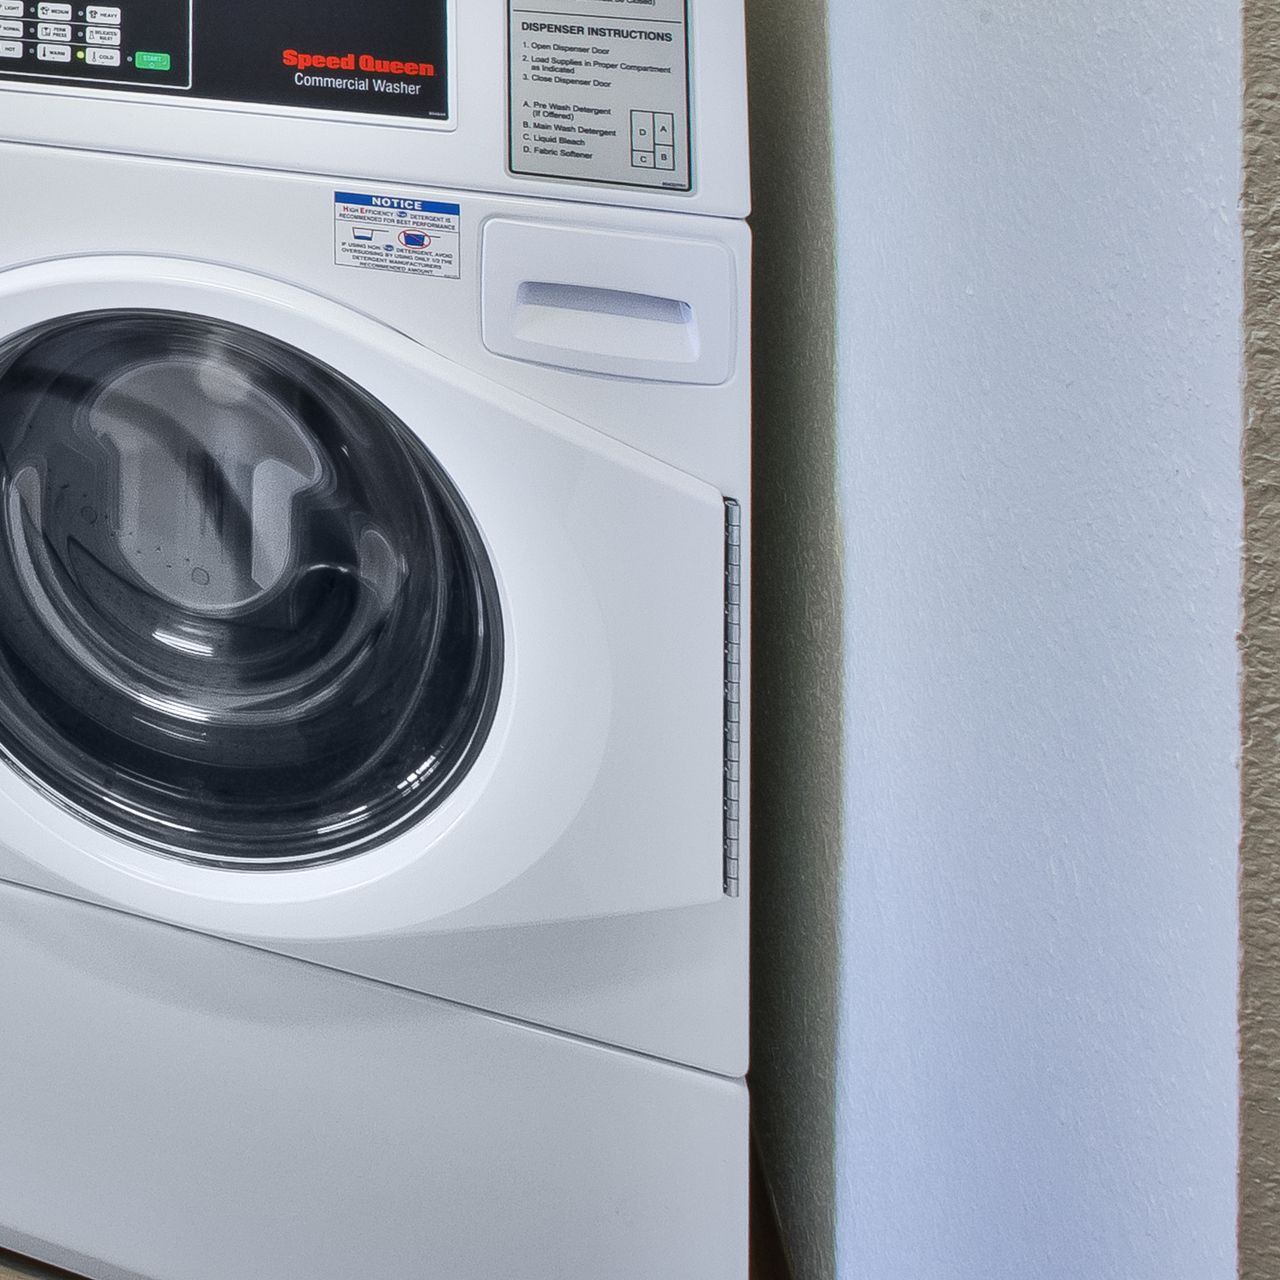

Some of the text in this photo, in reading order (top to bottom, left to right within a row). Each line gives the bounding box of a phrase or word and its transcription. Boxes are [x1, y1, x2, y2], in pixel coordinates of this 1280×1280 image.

[522, 22, 672, 41] DISPENSER INSTRUCTIONS
[531, 42, 551, 50] Open
[553, 44, 590, 53] Dispenser
[283, 49, 434, 76] Speed Queen
[531, 56, 549, 64] Load
[551, 58, 582, 67] Supplies
[593, 61, 618, 70] Proper
[620, 63, 671, 73] Compartment
[542, 65, 575, 74] Indicated
[294, 73, 421, 95] Commercial Washer
[554, 76, 591, 86] Dispenser
[534, 102, 547, 110] Pre
[549, 103, 570, 112] Wash
[573, 106, 611, 115] Detergent
[542, 111, 574, 121] Offered)
[533, 122, 552, 130] Main
[554, 124, 575, 132] Wash
[578, 126, 616, 136] Detergent
[640, 128, 646, 136] D
[534, 135, 556, 144] Liquid
[559, 137, 585, 145] Bleach
[534, 147, 558, 155] Fabric
[560, 149, 592, 158] Softener
[372, 197, 422, 209] NOTICE
[360, 207, 393, 216] EFFICIENCY
[410, 214, 444, 222] DETERGENT
[339, 213, 382, 221] RECOMMENDED
[412, 221, 455, 230] PERFORMANCE
[352, 255, 387, 263] DETERGENT
